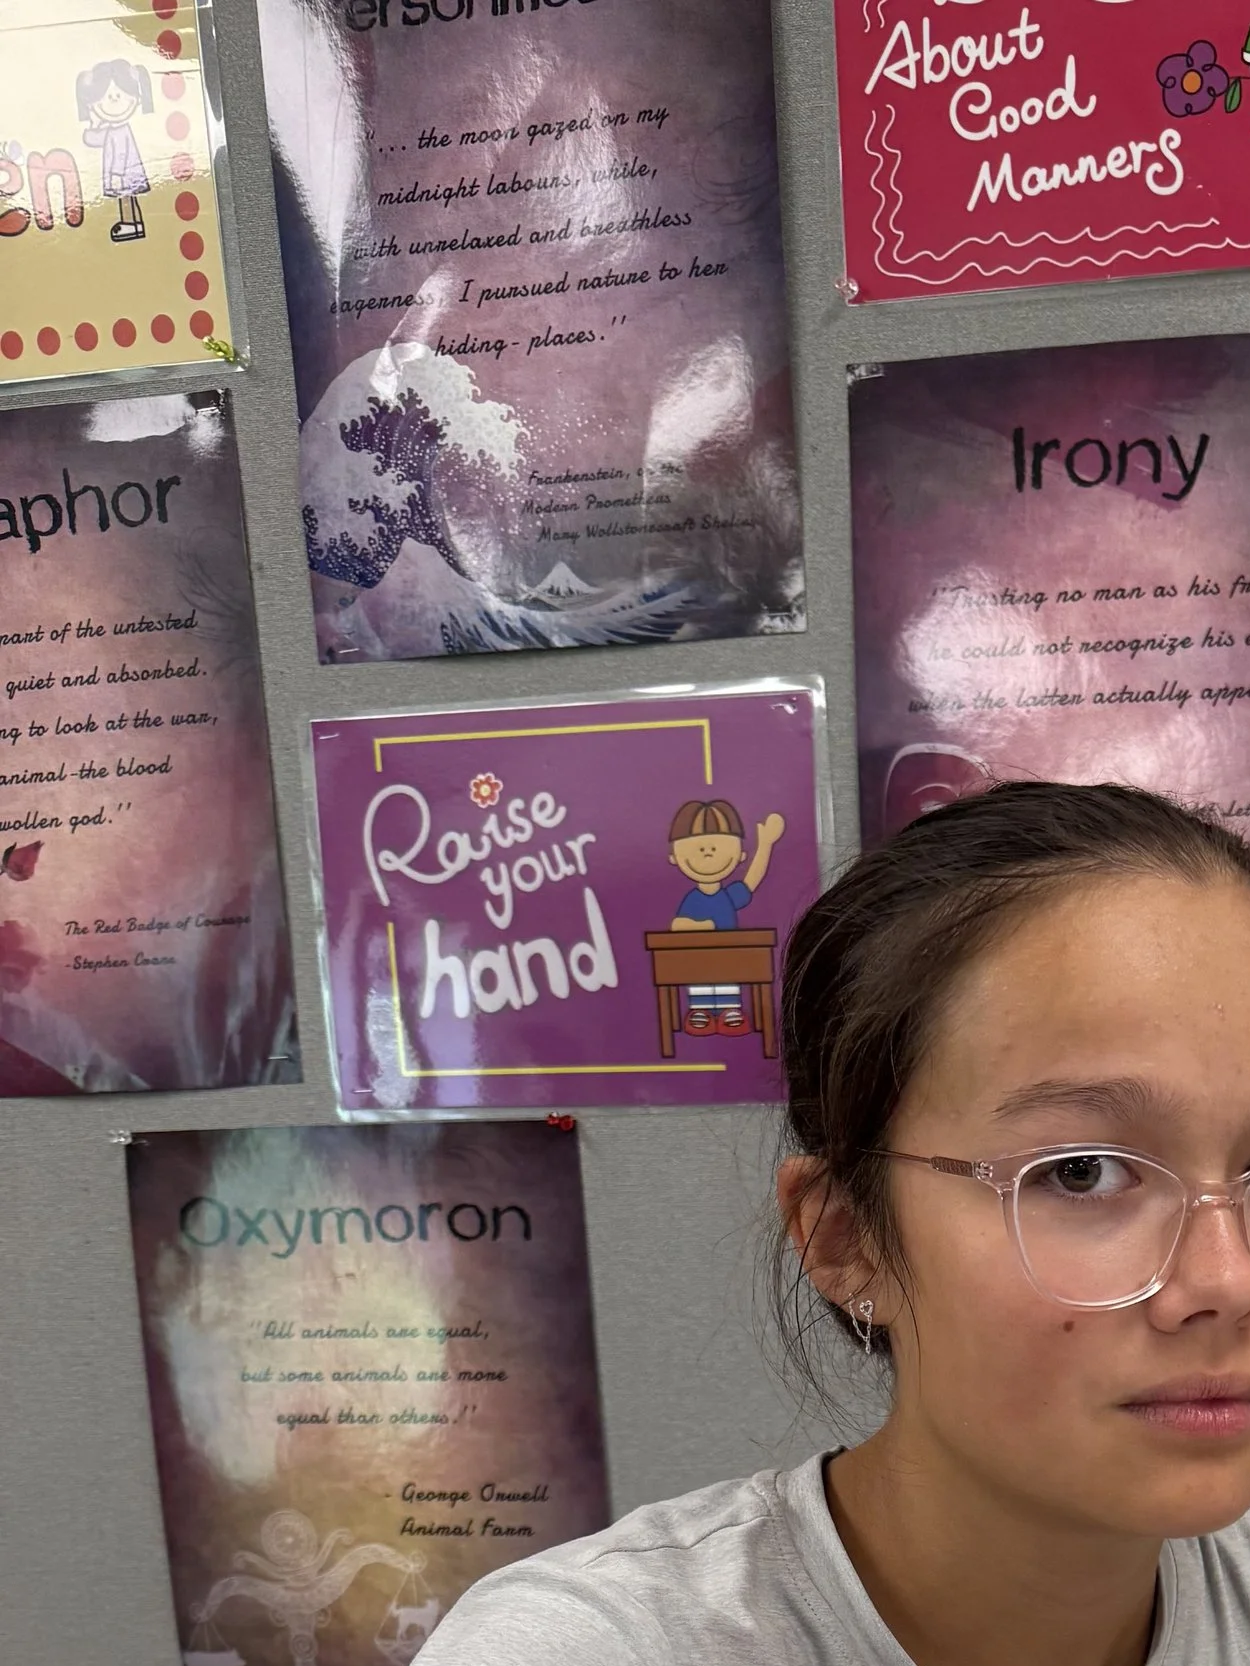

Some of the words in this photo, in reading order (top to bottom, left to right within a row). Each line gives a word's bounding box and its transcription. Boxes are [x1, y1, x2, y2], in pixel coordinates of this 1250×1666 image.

[865, 7, 1044, 95] About
[948, 54, 1096, 141] Good
[418, 126, 451, 150] the
[459, 126, 519, 147] moon
[527, 106, 594, 140] gazed
[637, 103, 669, 127] my
[966, 128, 1184, 213] Manners
[378, 182, 480, 207] midnight
[409, 223, 521, 254] unrelaxed
[529, 216, 572, 243] and
[478, 271, 569, 311] pursued
[577, 267, 651, 291] nature
[689, 254, 728, 278] her
[1011, 426, 1211, 502] Irony
[1056, 589, 1087, 605] no
[1093, 585, 1147, 602] man
[1187, 575, 1221, 597] his
[50, 622, 72, 644] of
[76, 618, 106, 639] the
[113, 610, 198, 637] untested
[1032, 635, 1073, 657] not
[1078, 632, 1194, 658] recognize
[1200, 627, 1236, 649] his
[6, 671, 57, 700] quiet
[61, 666, 100, 688] and
[107, 658, 208, 684] absorbed.
[1015, 687, 1085, 708] latter
[1092, 681, 1192, 710] actually
[29, 719, 49, 738] to
[55, 713, 100, 735] look
[133, 706, 164, 727] the
[117, 755, 173, 776] blood
[363, 783, 567, 908] Raise
[481, 831, 598, 931] your
[66, 920, 89, 936] The
[94, 919, 121, 934] Red
[127, 916, 172, 935] Badge
[175, 916, 193, 930] of
[419, 887, 619, 1020] hand
[179, 1194, 533, 1260] Oxymoron
[300, 1321, 381, 1342] animals
[278, 1368, 325, 1386] some
[331, 1365, 411, 1385] animals
[456, 1368, 509, 1384] more
[276, 1408, 330, 1432] equal
[337, 1407, 383, 1426] than
[401, 1482, 473, 1504] George
[479, 1482, 551, 1502] Orwell
[400, 1519, 475, 1538] Animal
[479, 1521, 536, 1538] Farm
